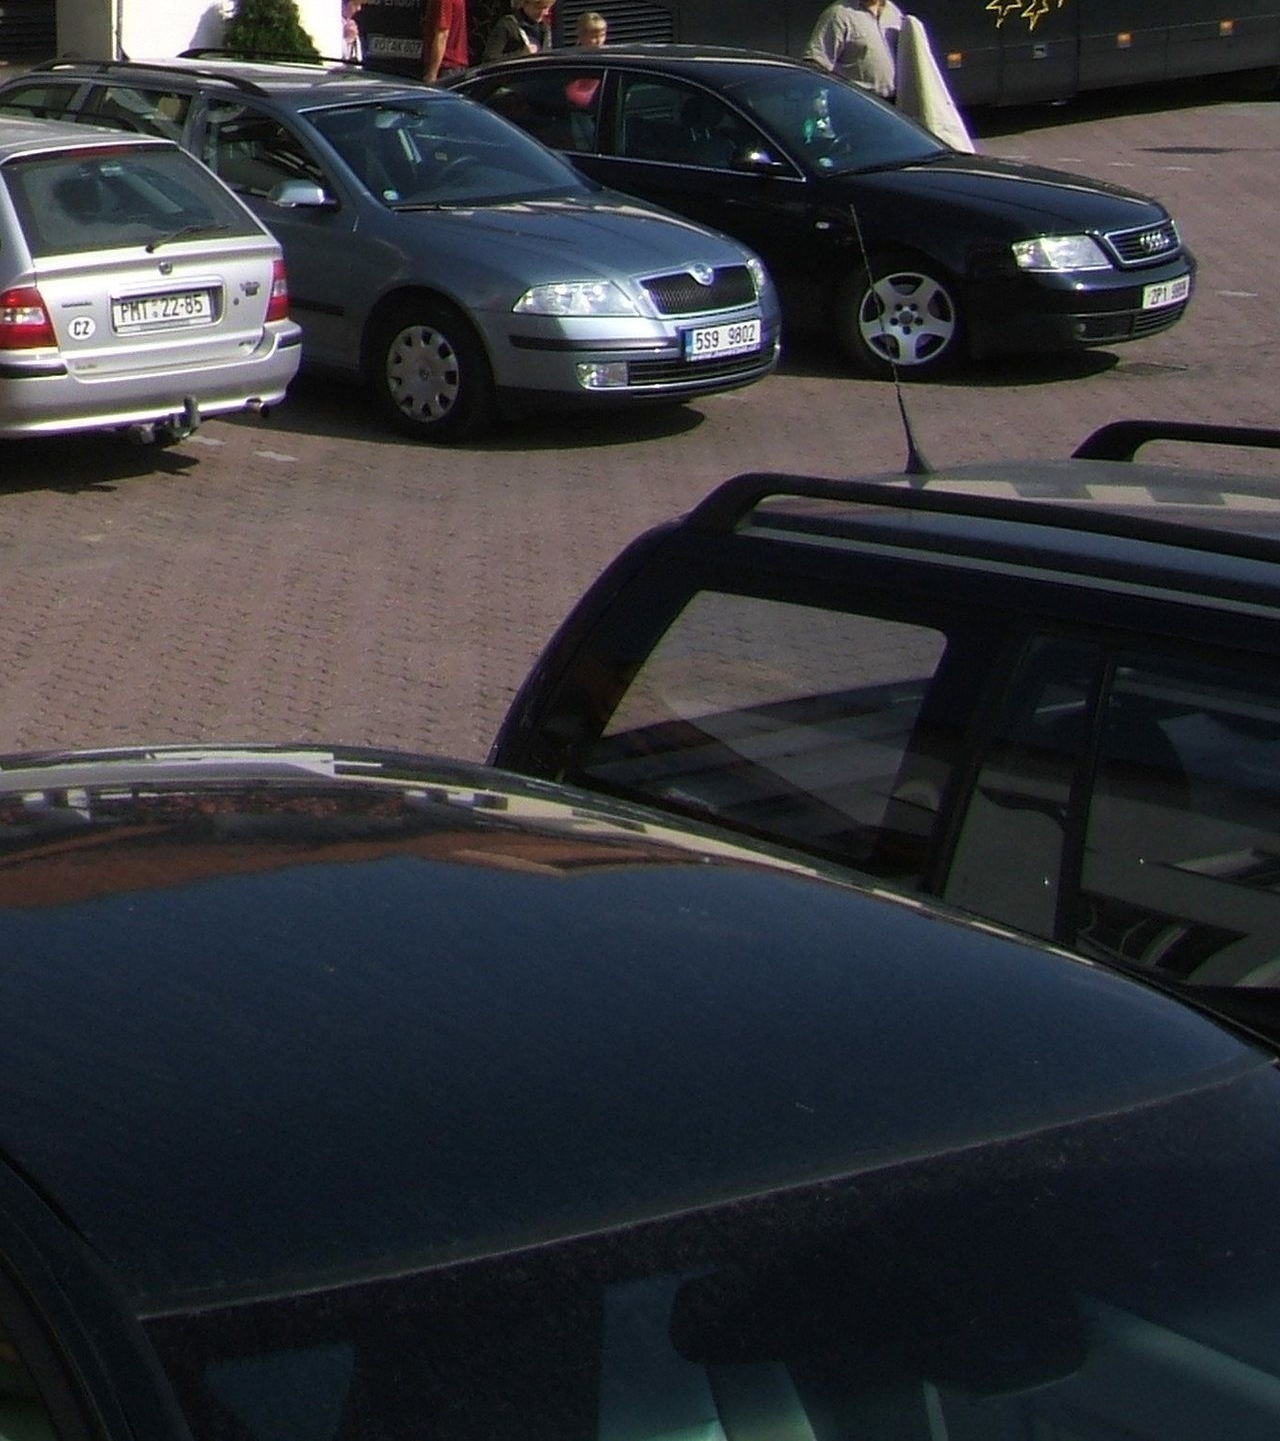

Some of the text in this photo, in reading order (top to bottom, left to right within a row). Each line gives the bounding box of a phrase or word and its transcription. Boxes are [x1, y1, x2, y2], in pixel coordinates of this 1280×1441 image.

[161, 293, 204, 318] 22-85
[73, 319, 90, 336] CZ
[696, 330, 720, 351] 5S9
